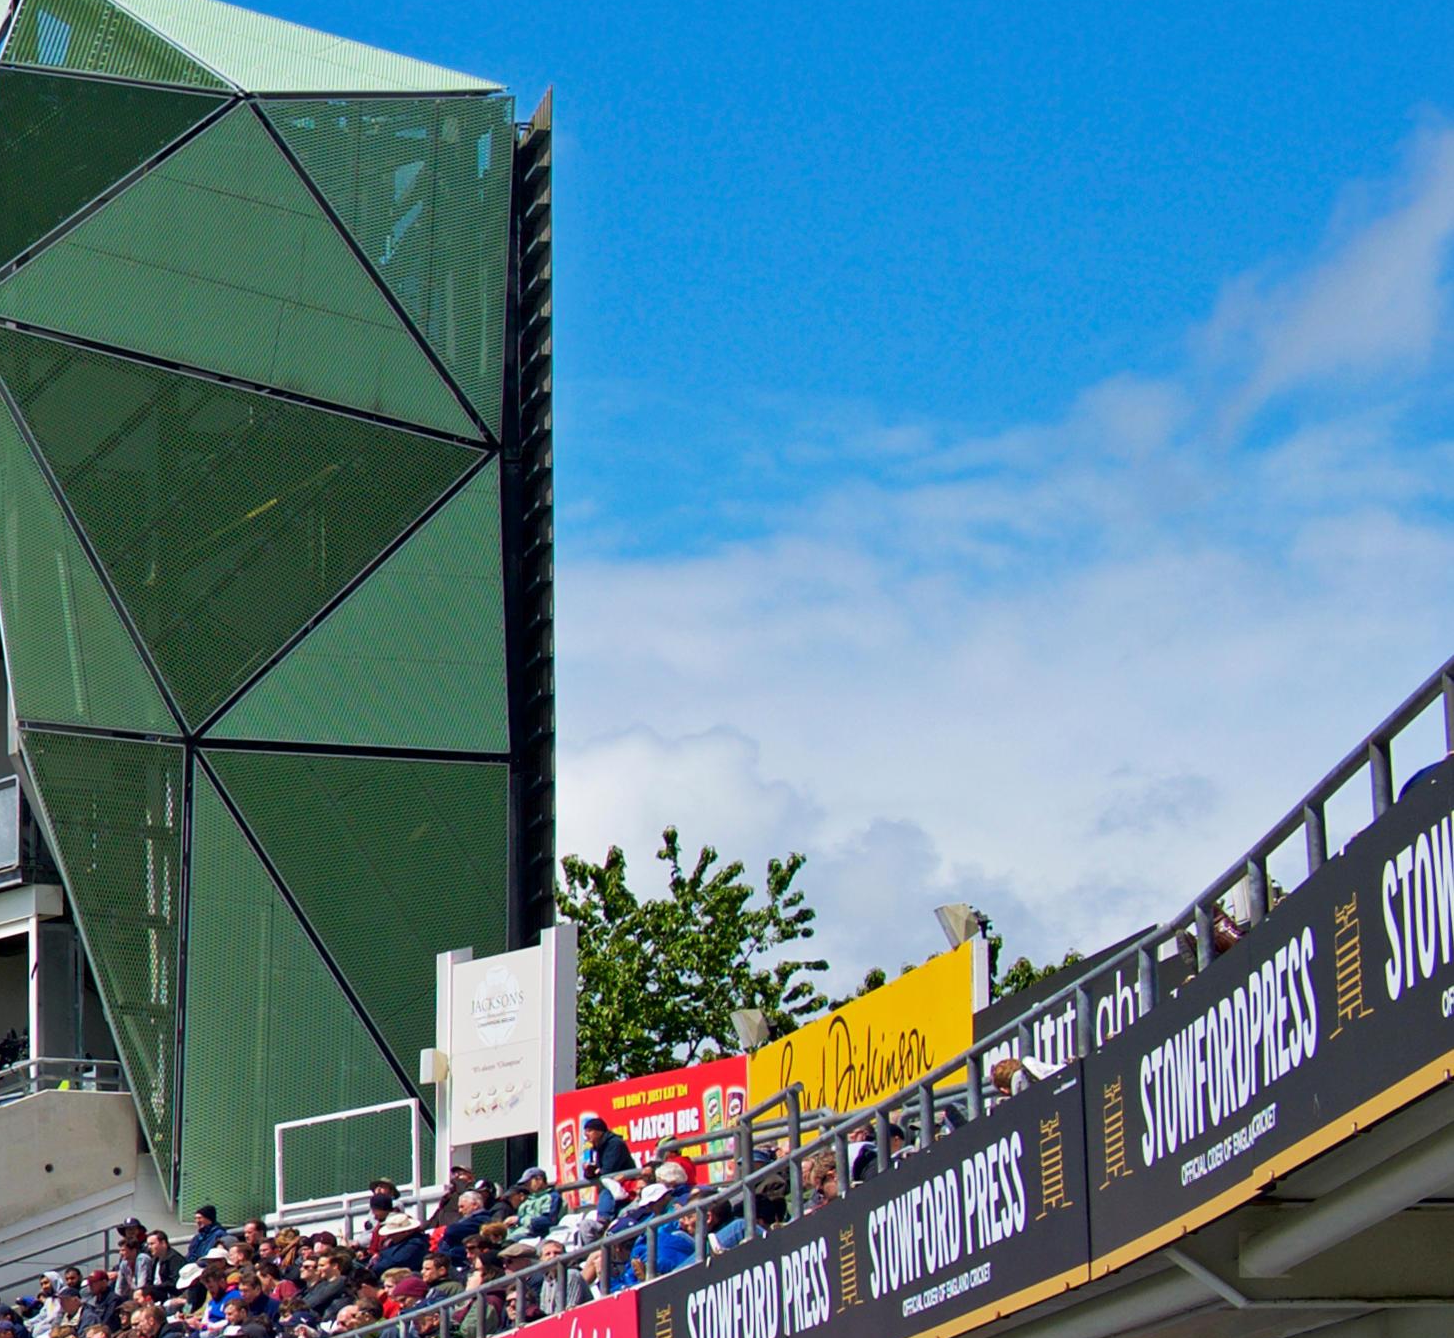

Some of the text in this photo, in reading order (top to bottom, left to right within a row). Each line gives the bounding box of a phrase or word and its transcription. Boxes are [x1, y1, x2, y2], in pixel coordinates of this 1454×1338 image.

[629, 1112, 675, 1142] WATCH
[676, 1107, 700, 1135] BIG
[868, 1129, 1027, 1299] STOWFORD PRESS
[781, 1236, 830, 1337] PRESS
